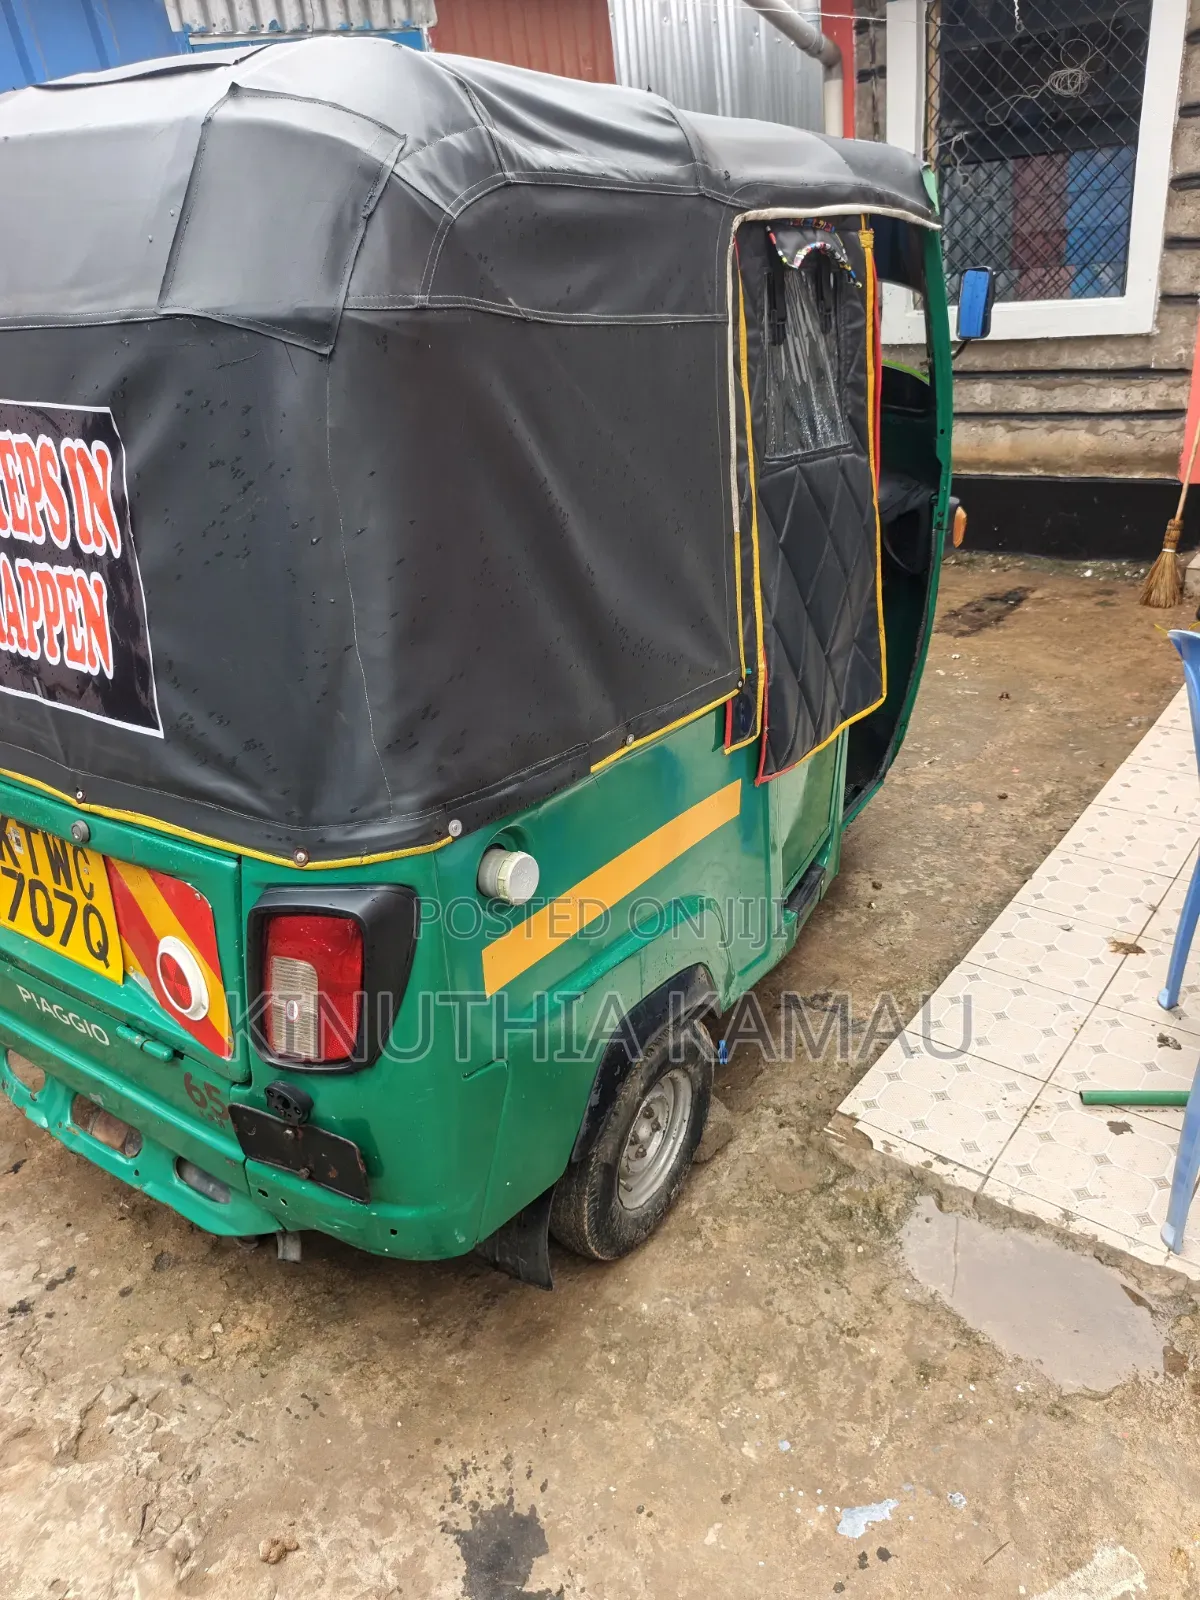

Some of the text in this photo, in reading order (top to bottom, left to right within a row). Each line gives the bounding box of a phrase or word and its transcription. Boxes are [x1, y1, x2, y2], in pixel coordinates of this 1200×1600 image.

[0, 429, 121, 558] EPS IN
[0, 552, 114, 679] APPEN
[1, 866, 110, 969] 707Q
[16, 984, 110, 1046] PIAGGIO
[184, 1071, 230, 1120] 65
